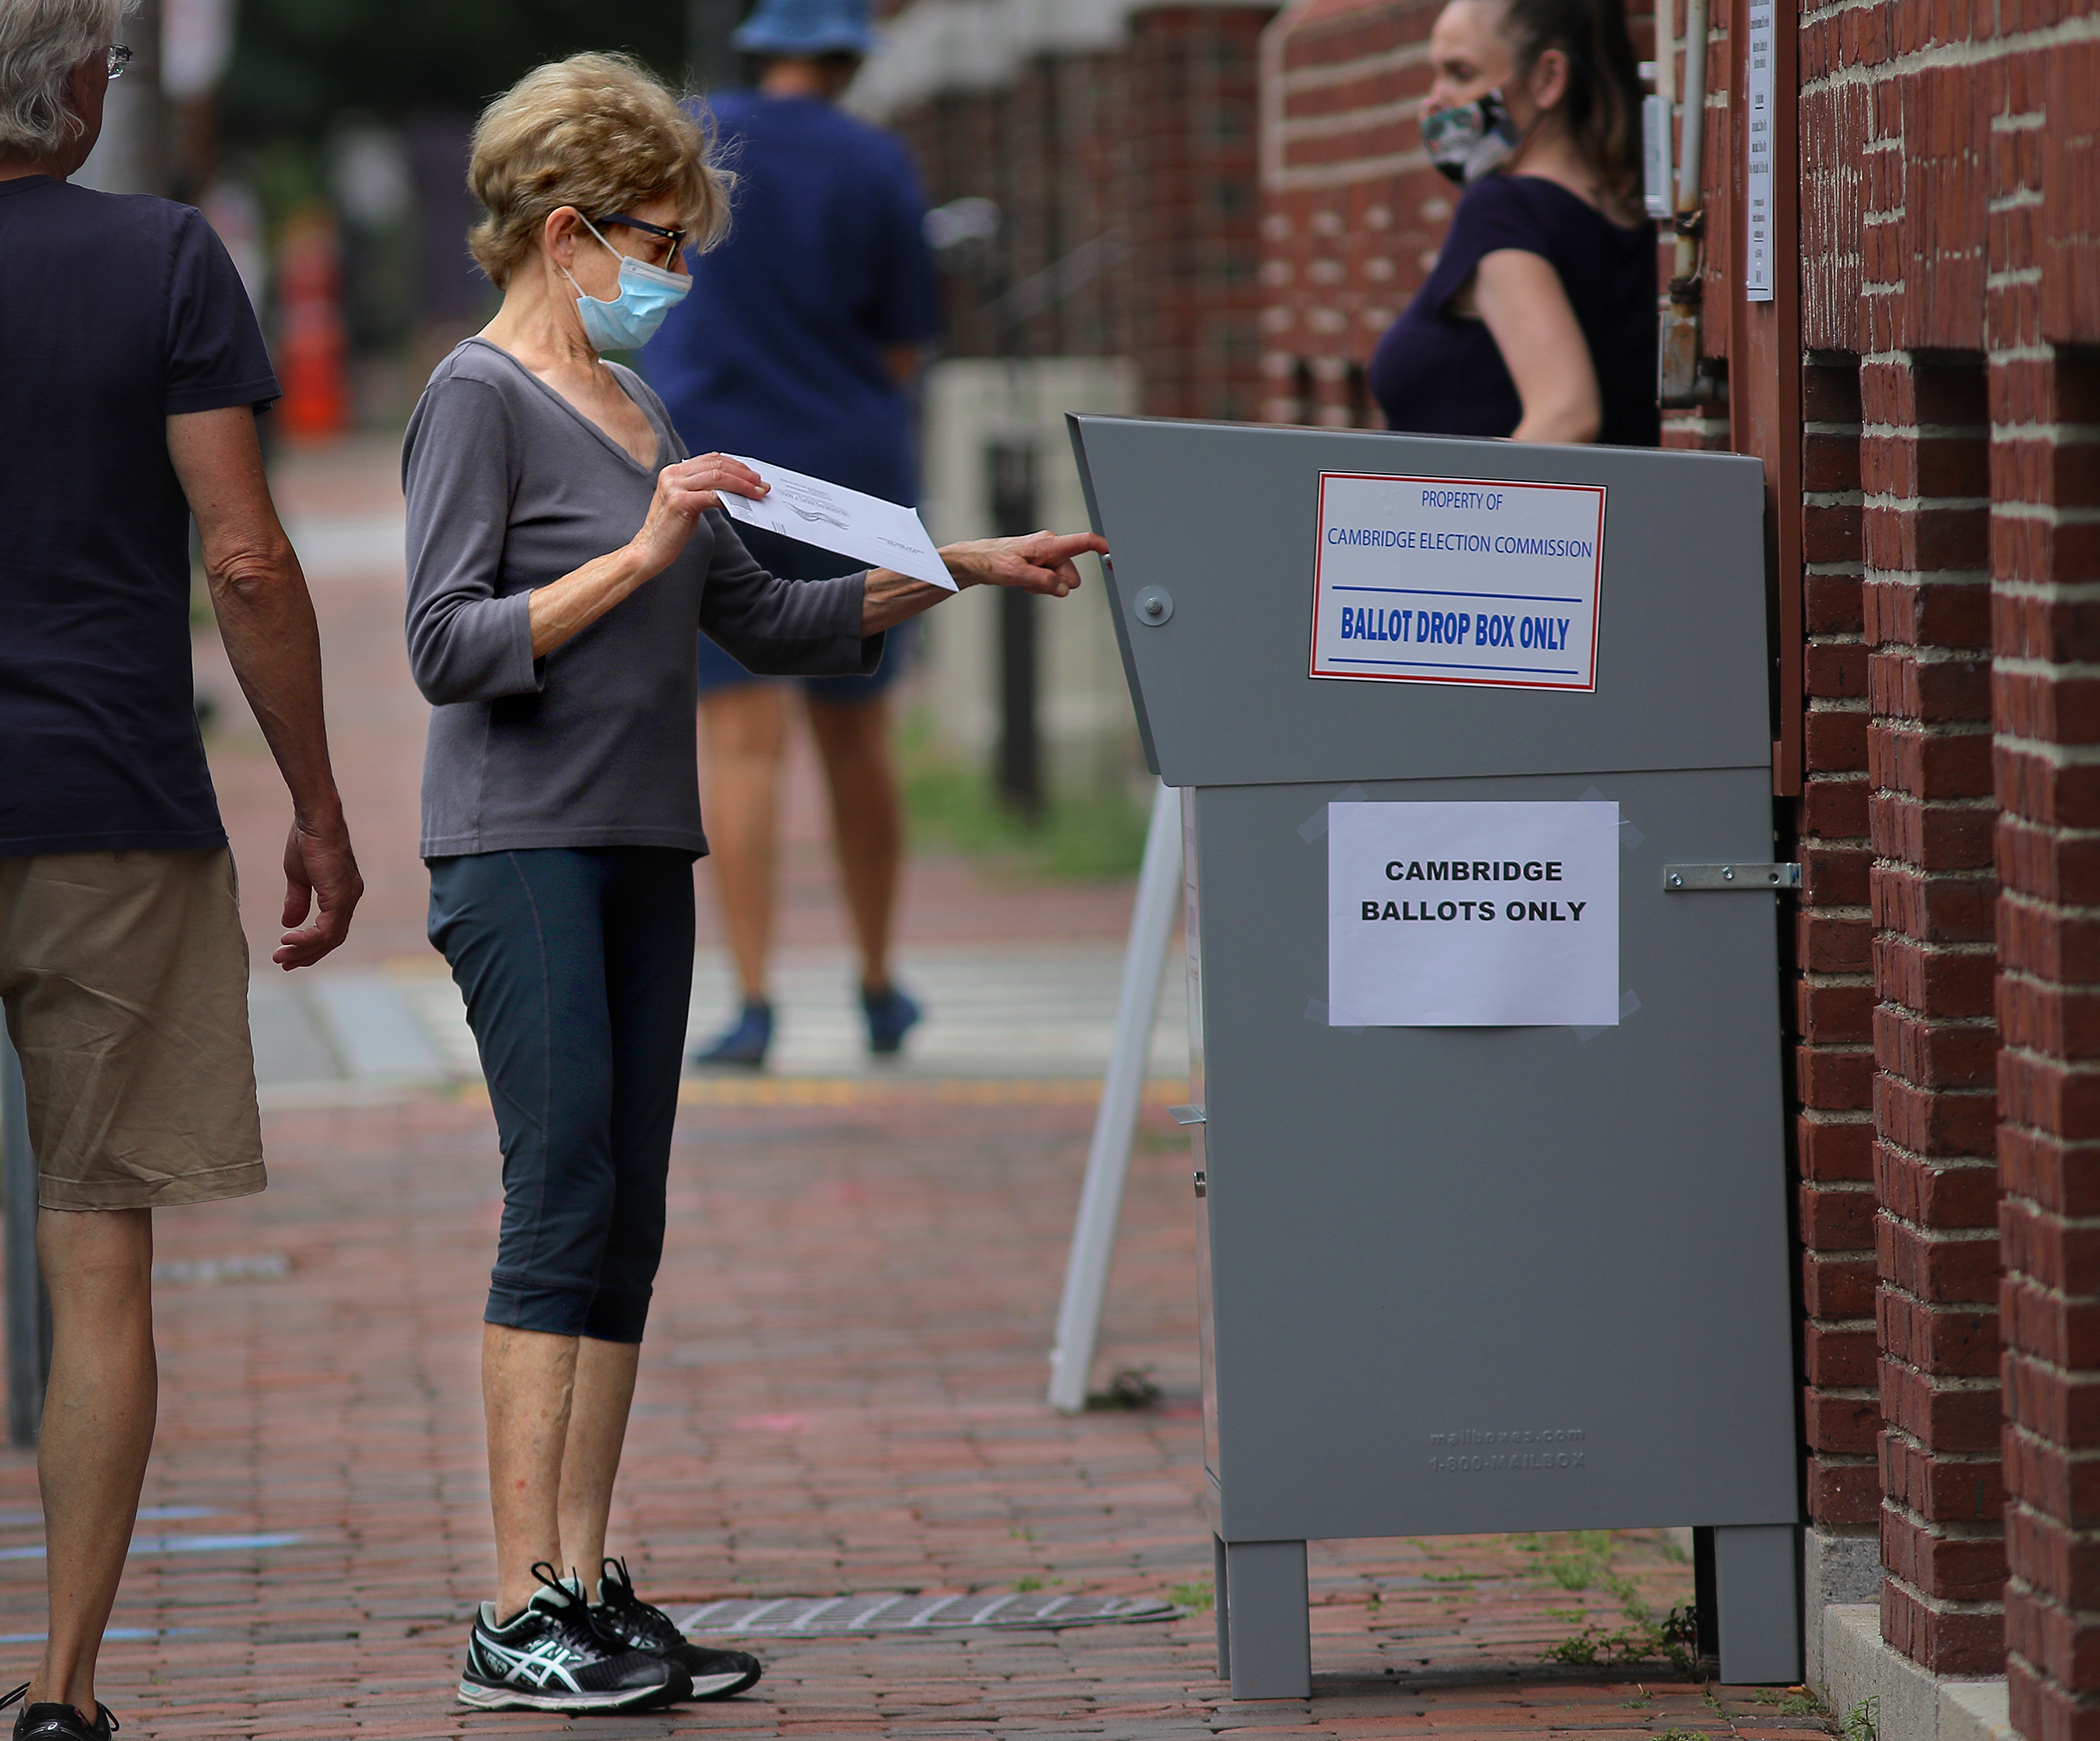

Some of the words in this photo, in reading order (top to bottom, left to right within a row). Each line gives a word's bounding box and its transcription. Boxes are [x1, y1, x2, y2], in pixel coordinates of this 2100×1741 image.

[1421, 490, 1484, 510] PROPERTY
[1486, 493, 1503, 510] OF
[1327, 527, 1416, 549] CAMBRIDGE
[1419, 532, 1491, 552] ELECTION
[1494, 536, 1593, 558] COMMISSION
[1340, 606, 1413, 643] BALLOT
[1416, 610, 1471, 645] DROP
[1474, 613, 1516, 648] BOX
[1519, 616, 1571, 651] ONLY
[1385, 861, 1563, 881] CAMBRIDGE
[1361, 901, 1496, 921] BALLOTS
[1505, 901, 1587, 921] ONLY
[1430, 1429, 1585, 1446] mailboxes.com
[1430, 1452, 1585, 1473] 1-800-MAILBOX
